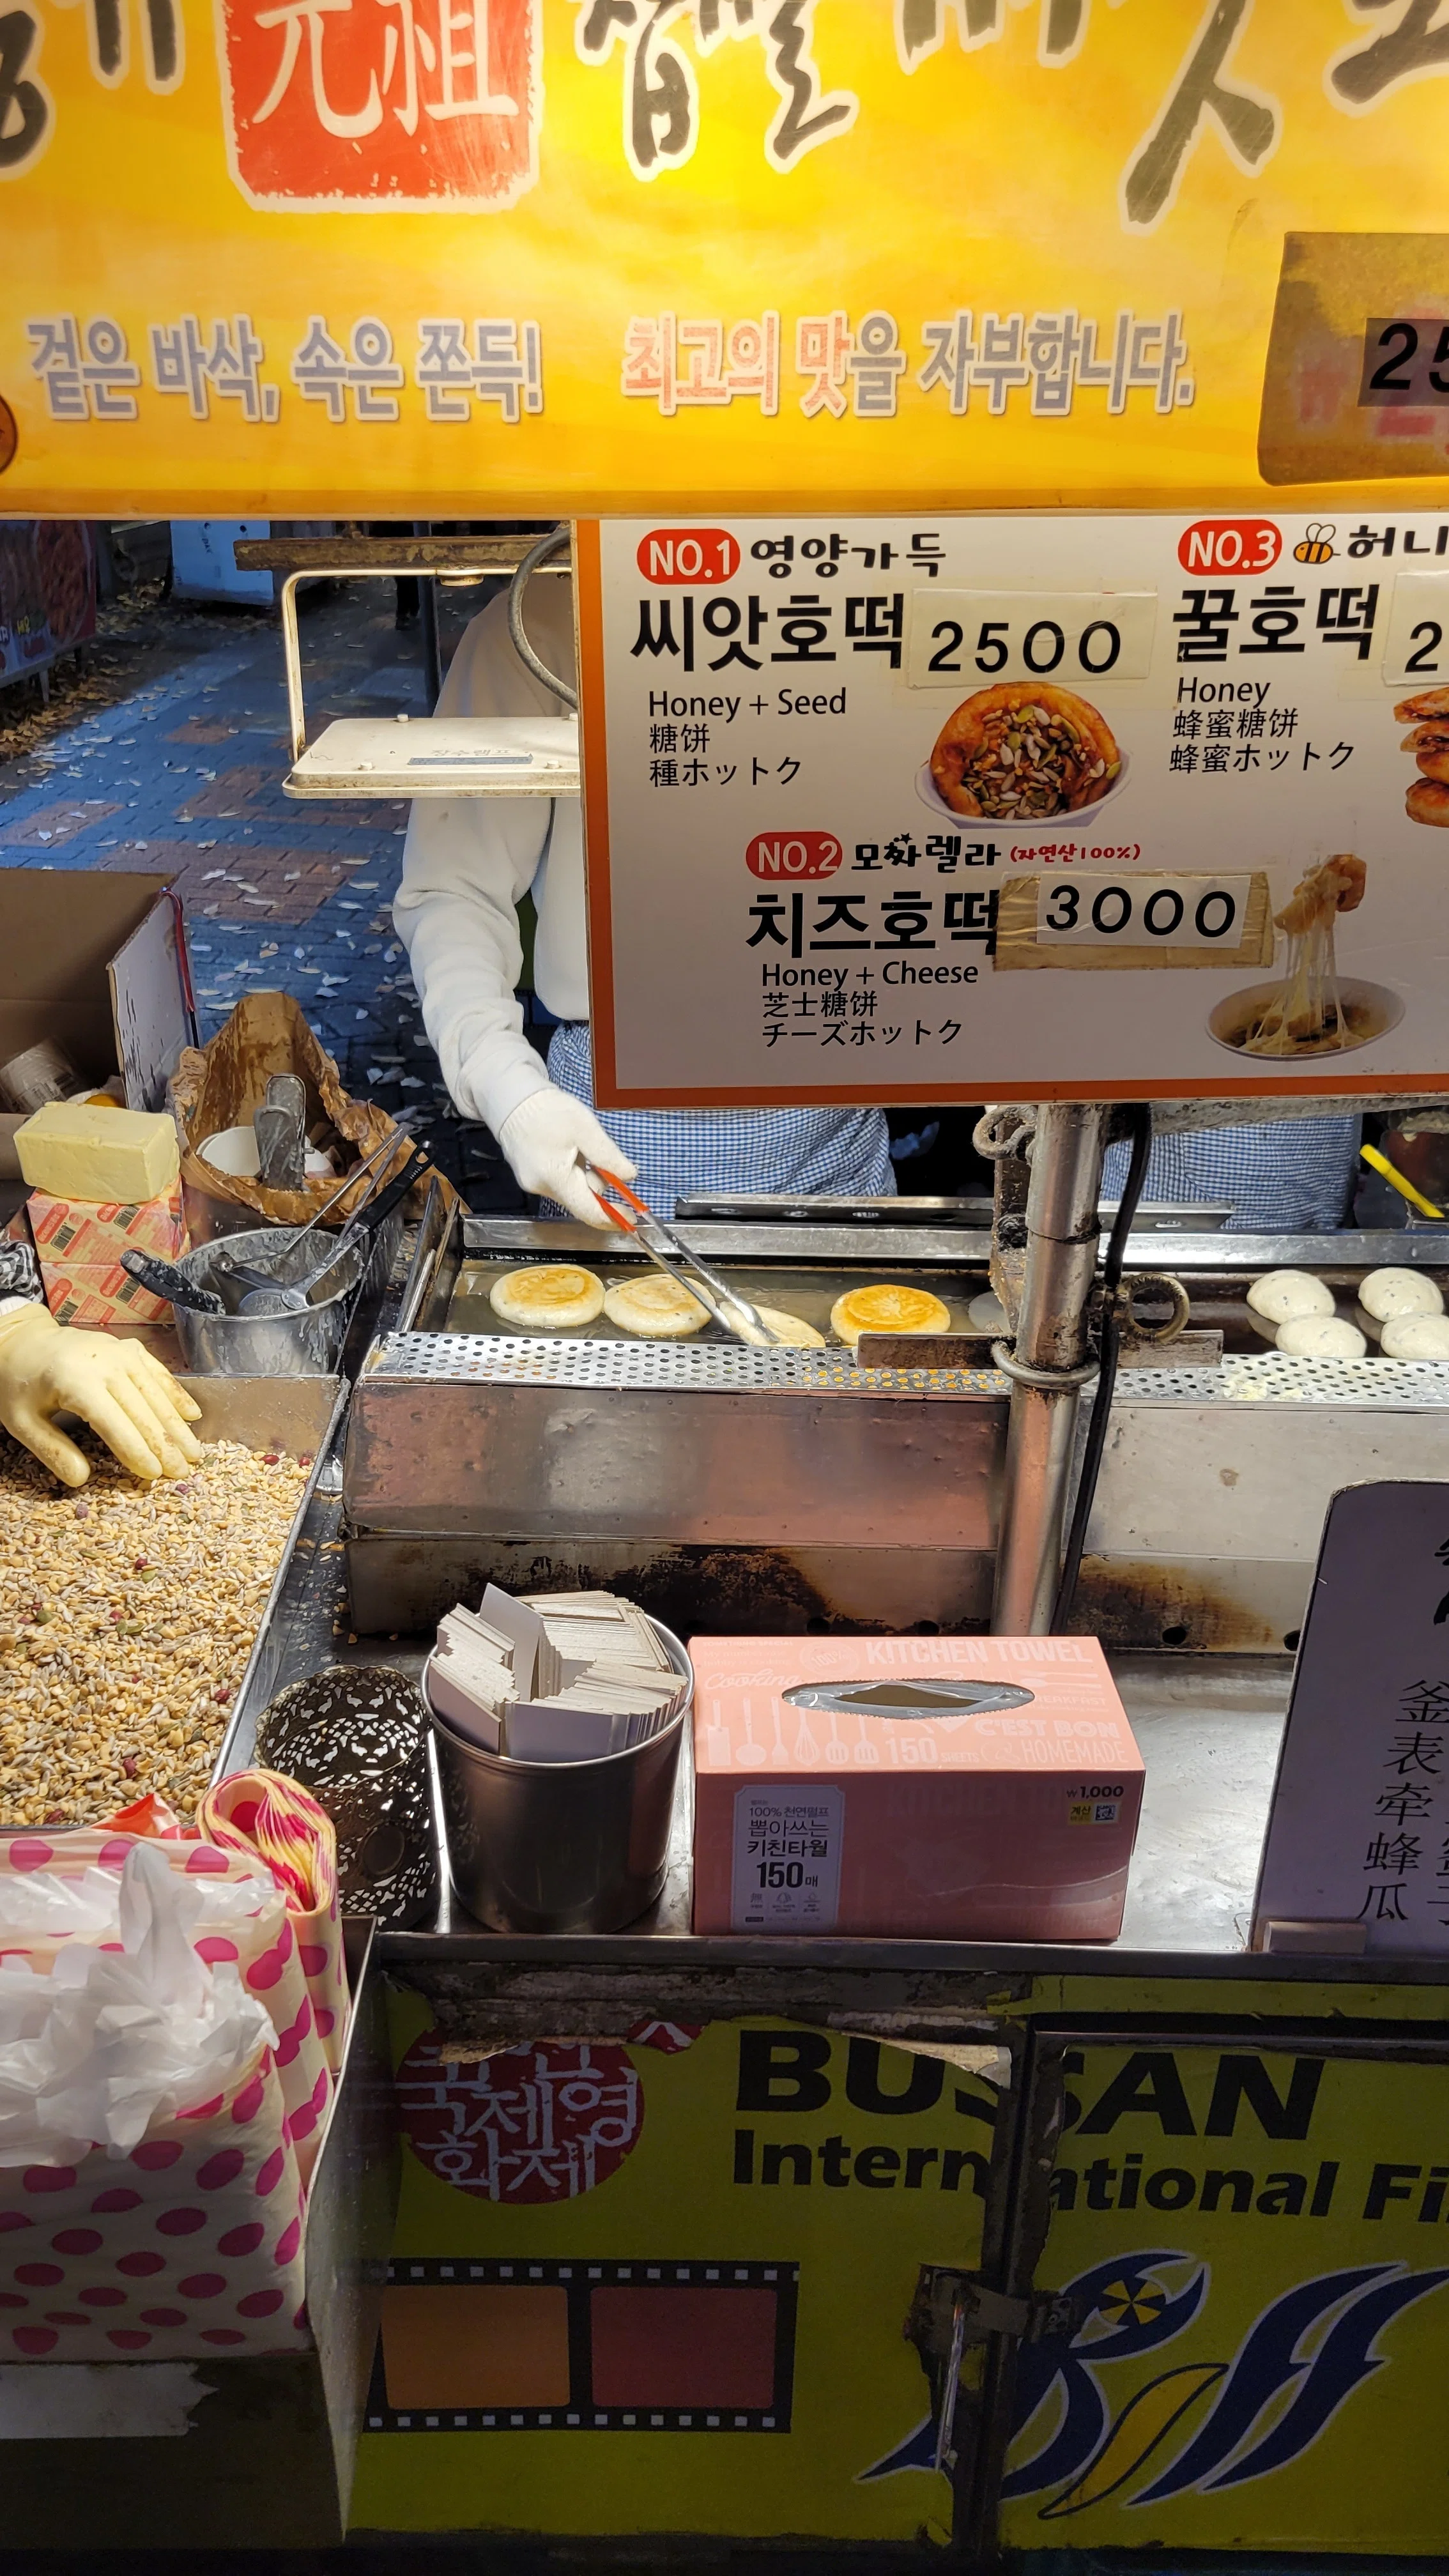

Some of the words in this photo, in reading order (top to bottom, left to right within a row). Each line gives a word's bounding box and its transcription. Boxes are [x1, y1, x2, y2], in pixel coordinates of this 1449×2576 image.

[27, 318, 136, 415] 겉은
[151, 318, 275, 417] 바삭,
[294, 321, 401, 417] 속은
[418, 324, 539, 417] 쫀득!
[624, 316, 776, 410] 최고의
[800, 316, 903, 412] 맛을
[919, 314, 1192, 410] 자부합니다.
[648, 539, 731, 578] NO.1
[750, 532, 946, 579] 영양가득
[1187, 530, 1277, 570] NO.3
[1346, 524, 1449, 559] 허니
[629, 593, 905, 673] 씨앗호떡
[1172, 583, 1381, 663] 꿀호떡
[927, 620, 1122, 675] 2500
[648, 690, 742, 724] Honey
[748, 694, 769, 716] +
[777, 686, 847, 716] Seed
[1176, 676, 1272, 710] Honey
[648, 723, 711, 755] 糖饼
[1172, 706, 1299, 741] 蜂蜜糖饼
[648, 755, 801, 788] 種ホットク
[1169, 740, 1355, 774] 蜂蜜ホットク
[757, 839, 839, 875] NO.2
[744, 889, 1000, 959] 치즈호떡
[1045, 884, 1236, 939] 3000
[762, 962, 849, 992] Honey
[855, 966, 875, 986] +
[882, 960, 979, 985] Cheese
[762, 990, 878, 1019] 芝士糖饼
[762, 1019, 963, 1048] チーズホットク
[866, 1639, 989, 1666] KITCHEN
[993, 1639, 1094, 1664] TOWEL
[1034, 1694, 1107, 1706] REAKFAST
[974, 1719, 1047, 1736] C'EST
[1054, 1720, 1121, 1738] BON
[885, 1737, 939, 1765] 150
[941, 1752, 979, 1763] SHEETS
[1020, 1739, 1129, 1765] HOMEMADE
[747, 1819, 830, 1838] 뽑아쓰는
[749, 1806, 783, 1818] 100%
[783, 1805, 830, 1818] 천연펄프
[747, 1839, 829, 1858] 키친타월
[1363, 1832, 1449, 1876] 蜂
[1362, 2163, 1449, 2223] Fi
